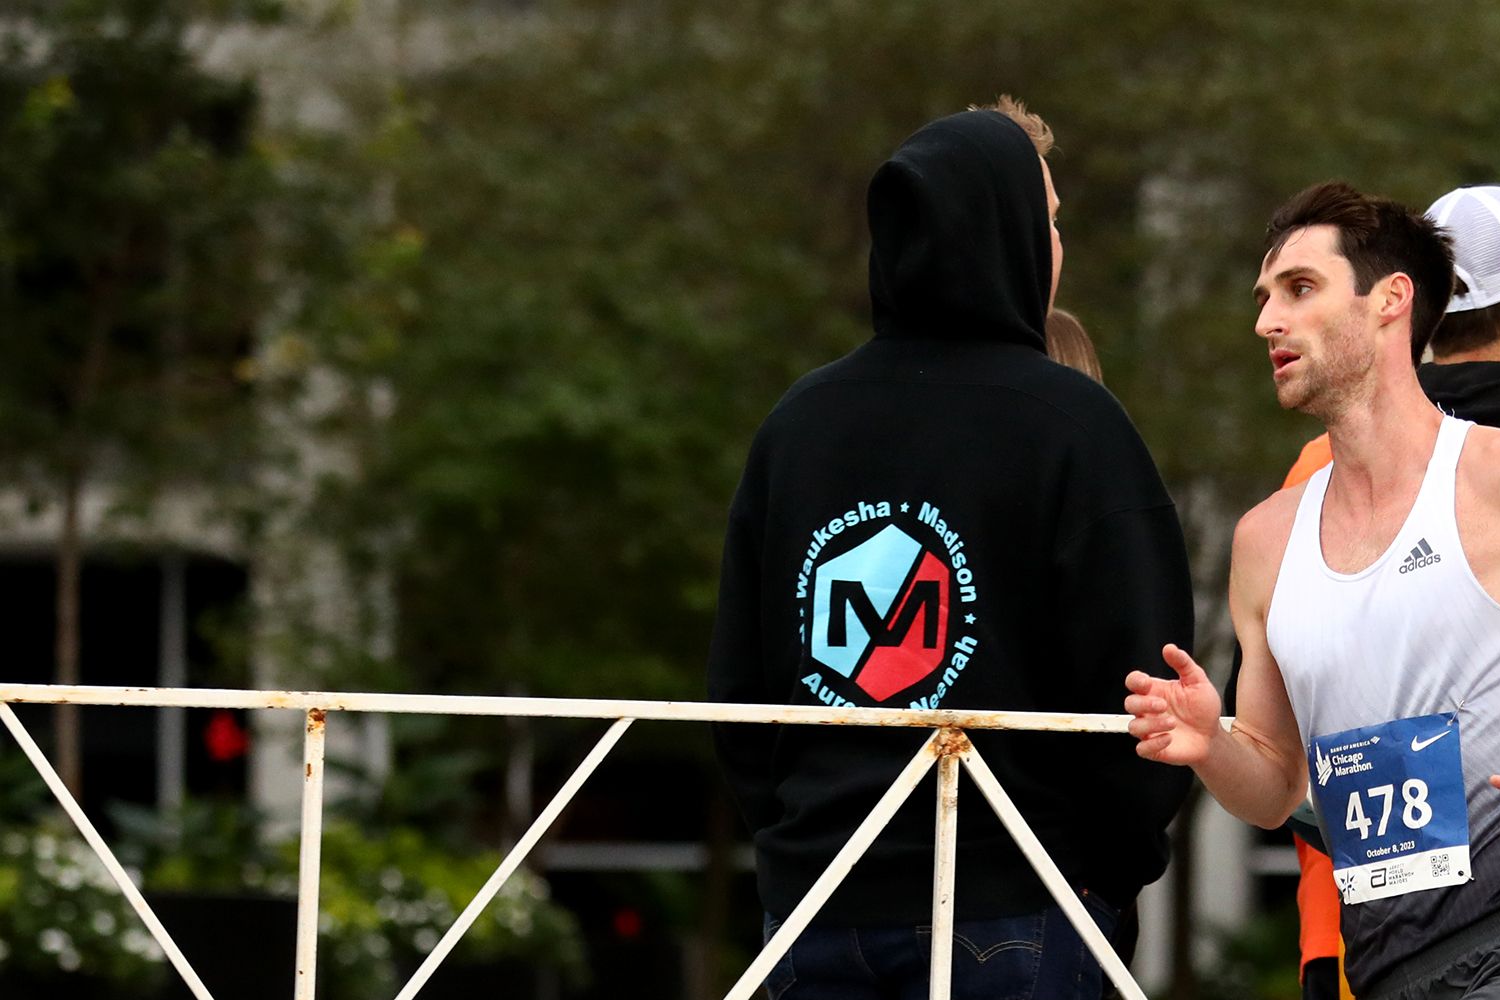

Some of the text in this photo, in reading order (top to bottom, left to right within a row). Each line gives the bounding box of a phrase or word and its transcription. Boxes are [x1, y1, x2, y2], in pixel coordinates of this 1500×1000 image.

[918, 502, 977, 602] Madison
[1399, 554, 1441, 574] adidas
[909, 636, 978, 709] Neenah
[1349, 740, 1371, 749] AMERICA
[1332, 752, 1363, 766] Chicago
[1335, 762, 1372, 777] Marathon
[1345, 778, 1433, 840] 478
[1366, 841, 1415, 858] October 8, 2023
